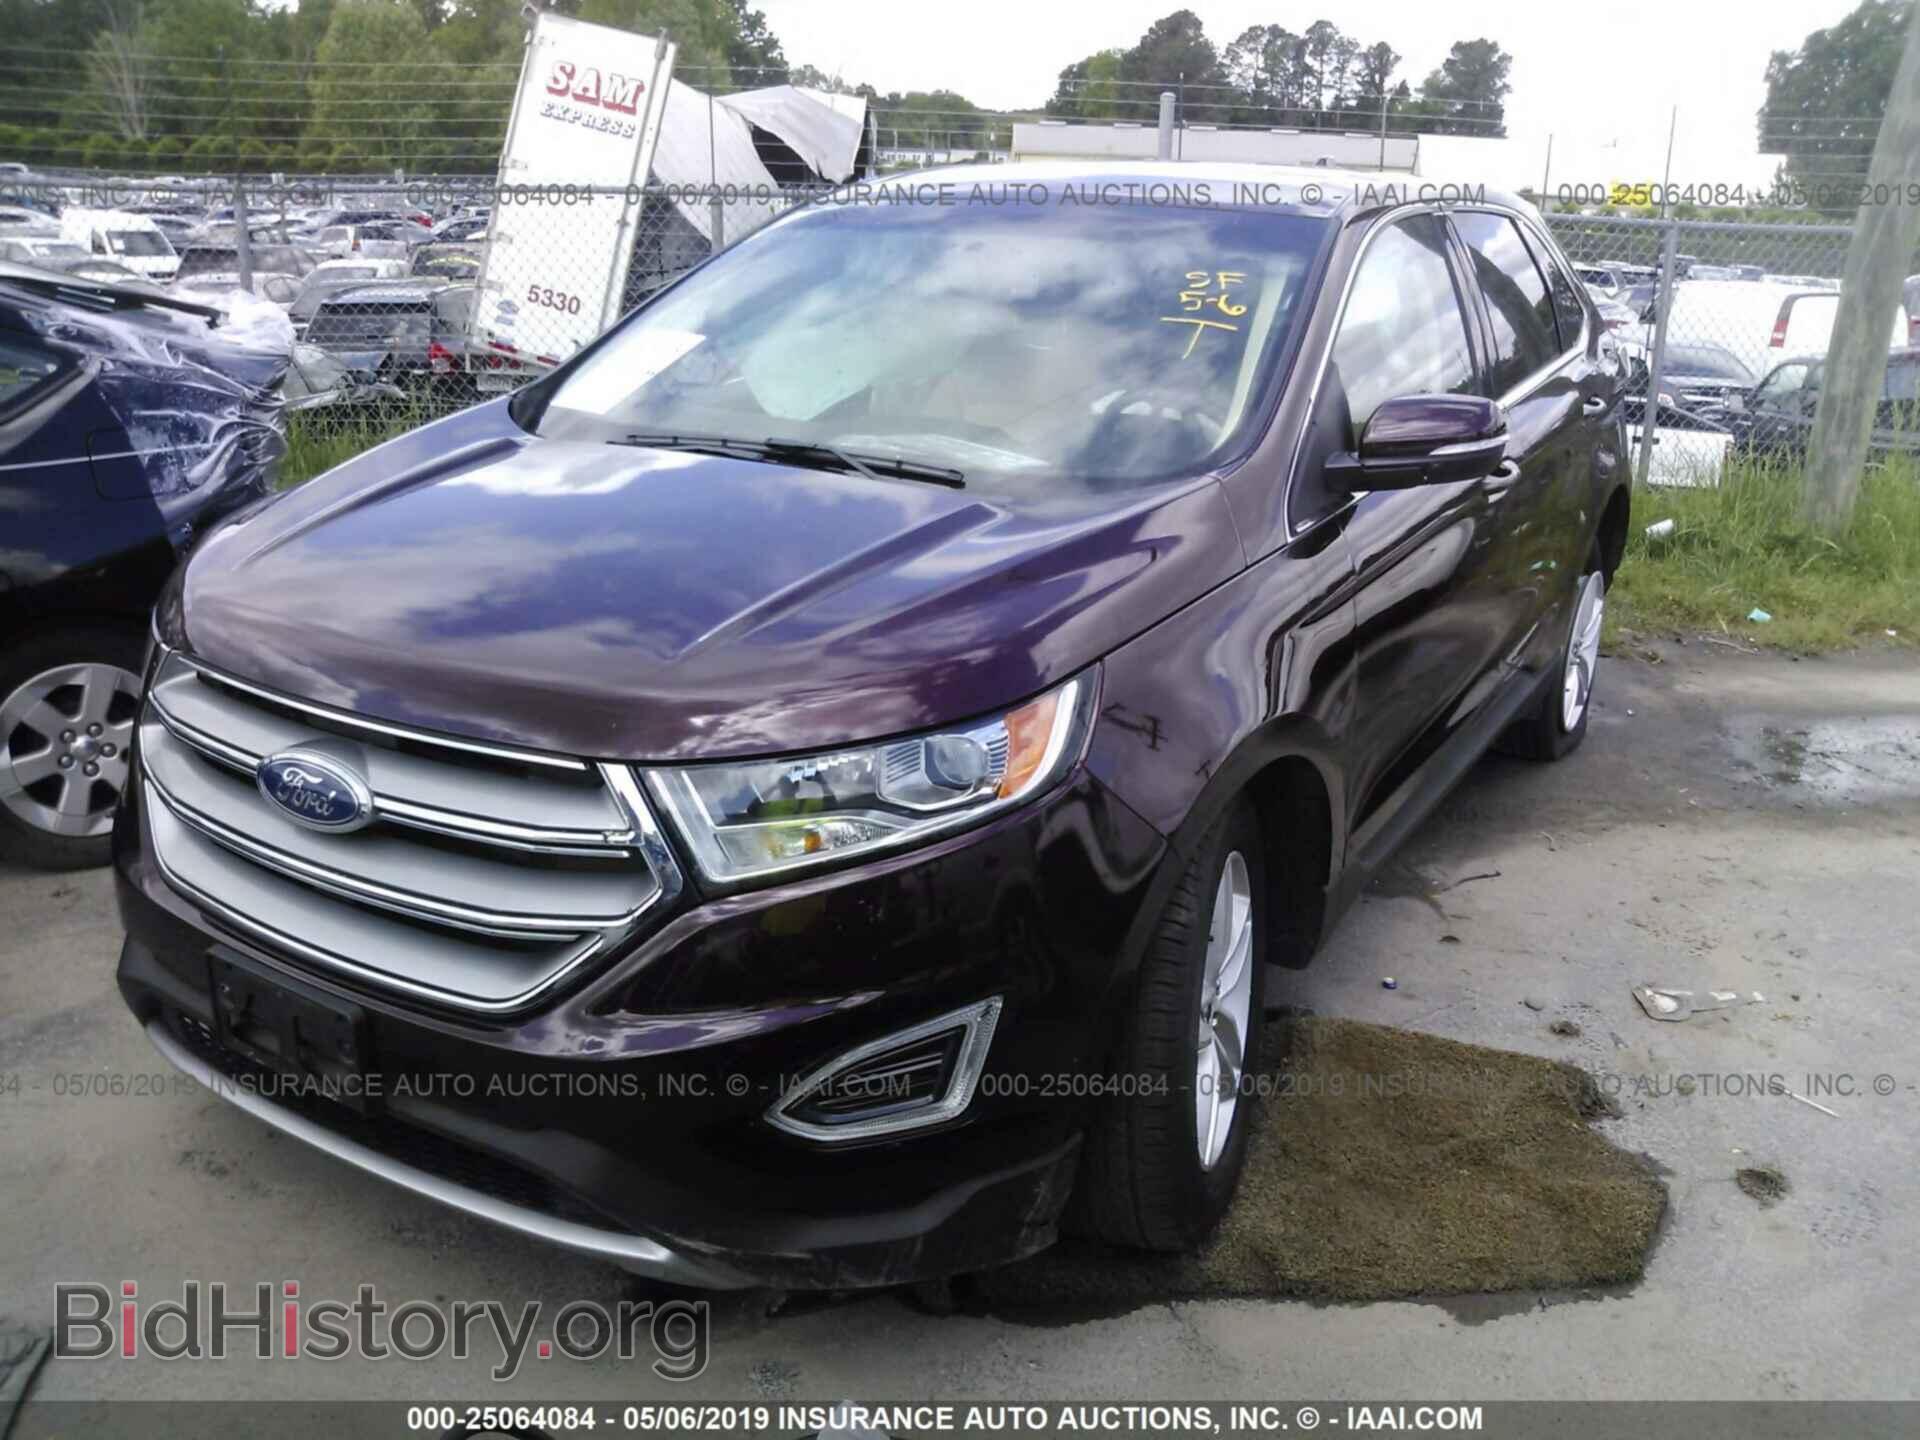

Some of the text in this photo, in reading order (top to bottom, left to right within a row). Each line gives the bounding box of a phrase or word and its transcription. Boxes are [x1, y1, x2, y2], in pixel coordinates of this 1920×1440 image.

[546, 61, 645, 116] SAM
[540, 102, 637, 139] EXPRESS
[1184, 271, 1248, 290] SF
[527, 284, 581, 316] 5330
[1178, 291, 1247, 316] 5-6
[276, 766, 336, 816] Ford
